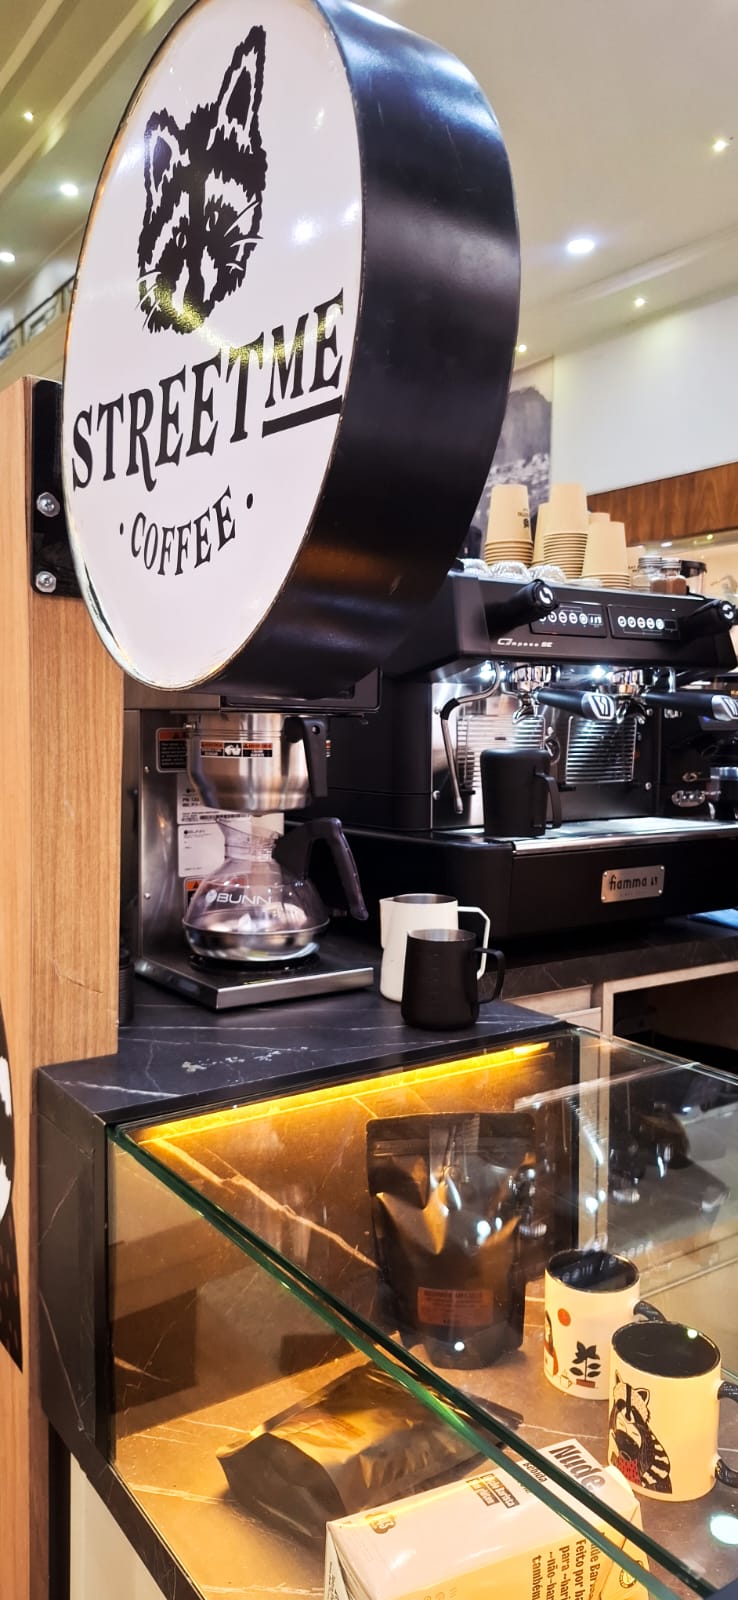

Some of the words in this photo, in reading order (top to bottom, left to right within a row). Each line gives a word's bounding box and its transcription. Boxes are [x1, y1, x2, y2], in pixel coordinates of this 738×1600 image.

[132, 485, 237, 576] COFFEE
[609, 875, 647, 891] fiamma
[216, 891, 271, 904] BUNN
[549, 1445, 606, 1490] Nude
[559, 1545, 571, 1571] para
[575, 1539, 586, 1567] Feito
[573, 1569, 584, 1587] por
